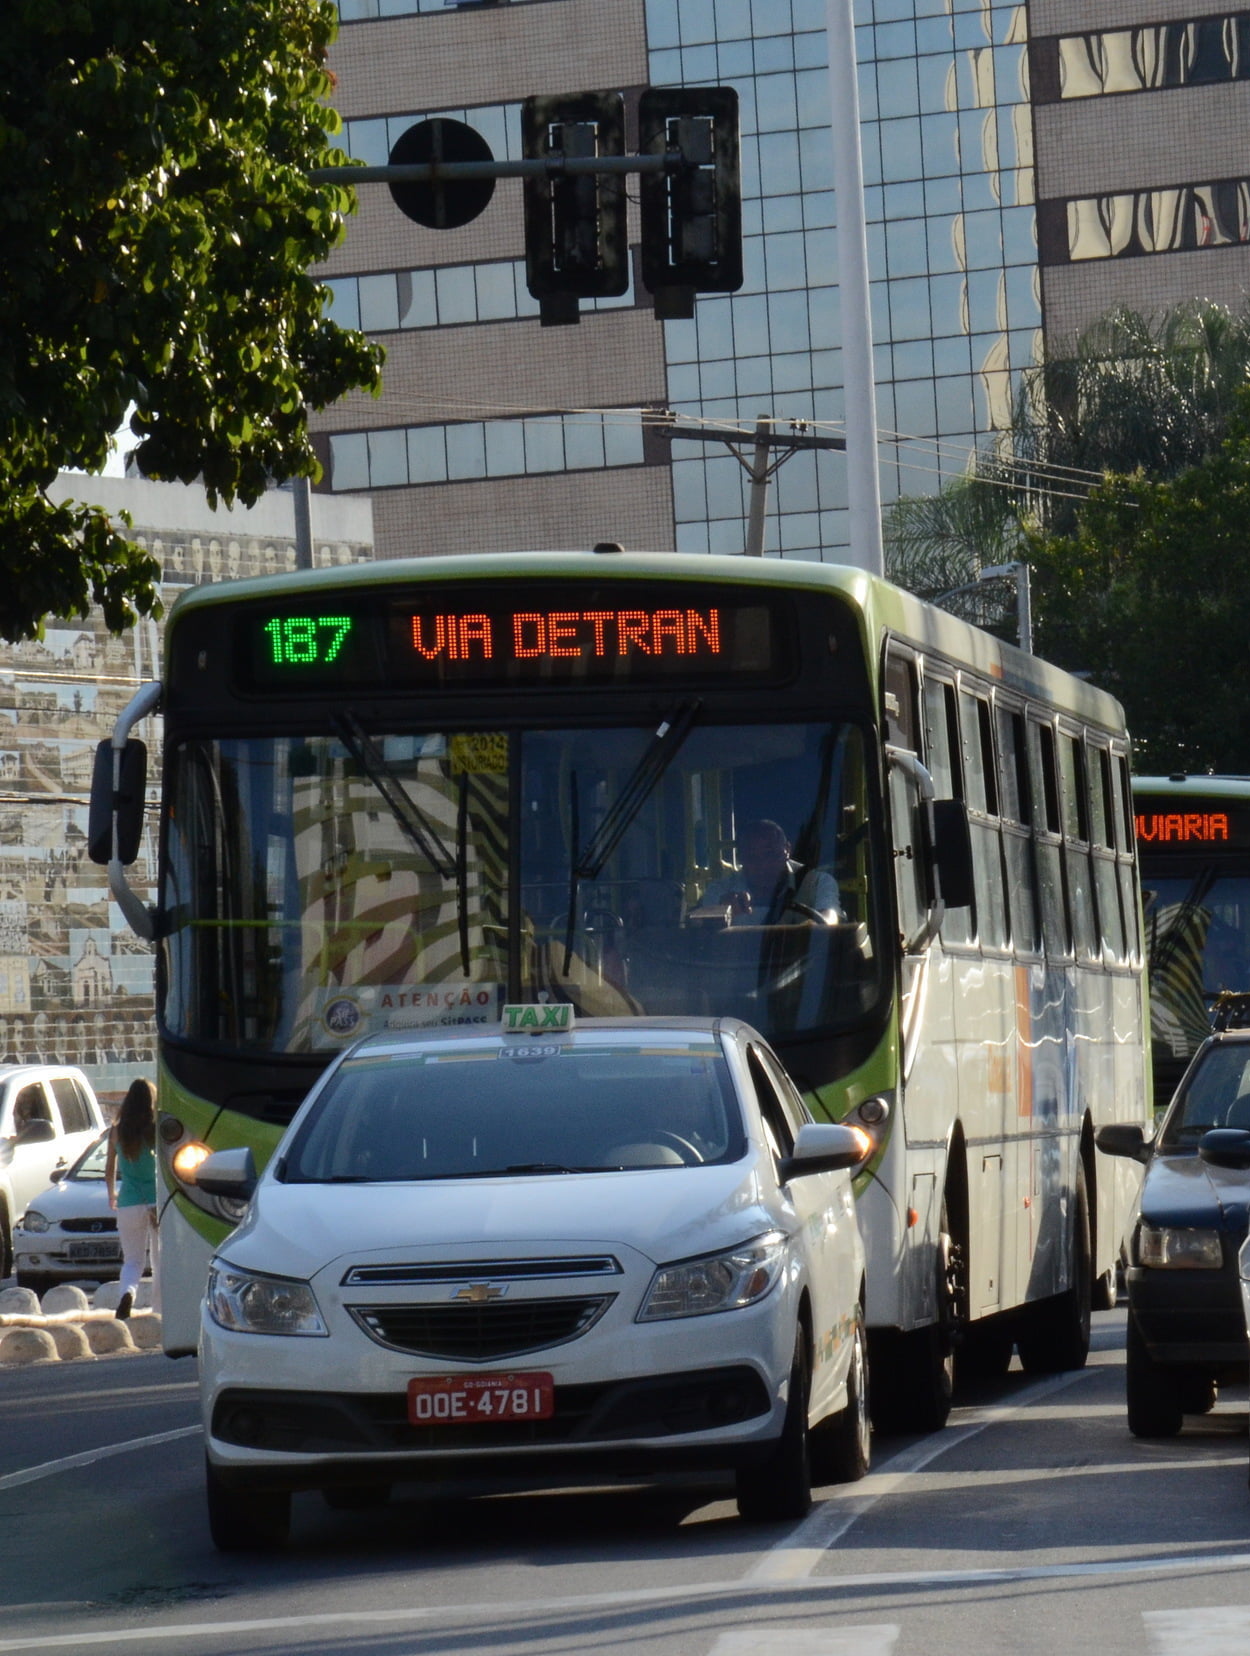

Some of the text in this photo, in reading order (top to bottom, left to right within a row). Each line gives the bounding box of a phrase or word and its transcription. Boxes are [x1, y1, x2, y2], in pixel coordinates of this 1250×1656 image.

[264, 608, 720, 663] 187 VIA DETRAN
[471, 736, 505, 752] 2014
[381, 988, 490, 1010] ATENÇÃO
[504, 1005, 569, 1028] TAXI
[504, 1046, 556, 1057] 1639
